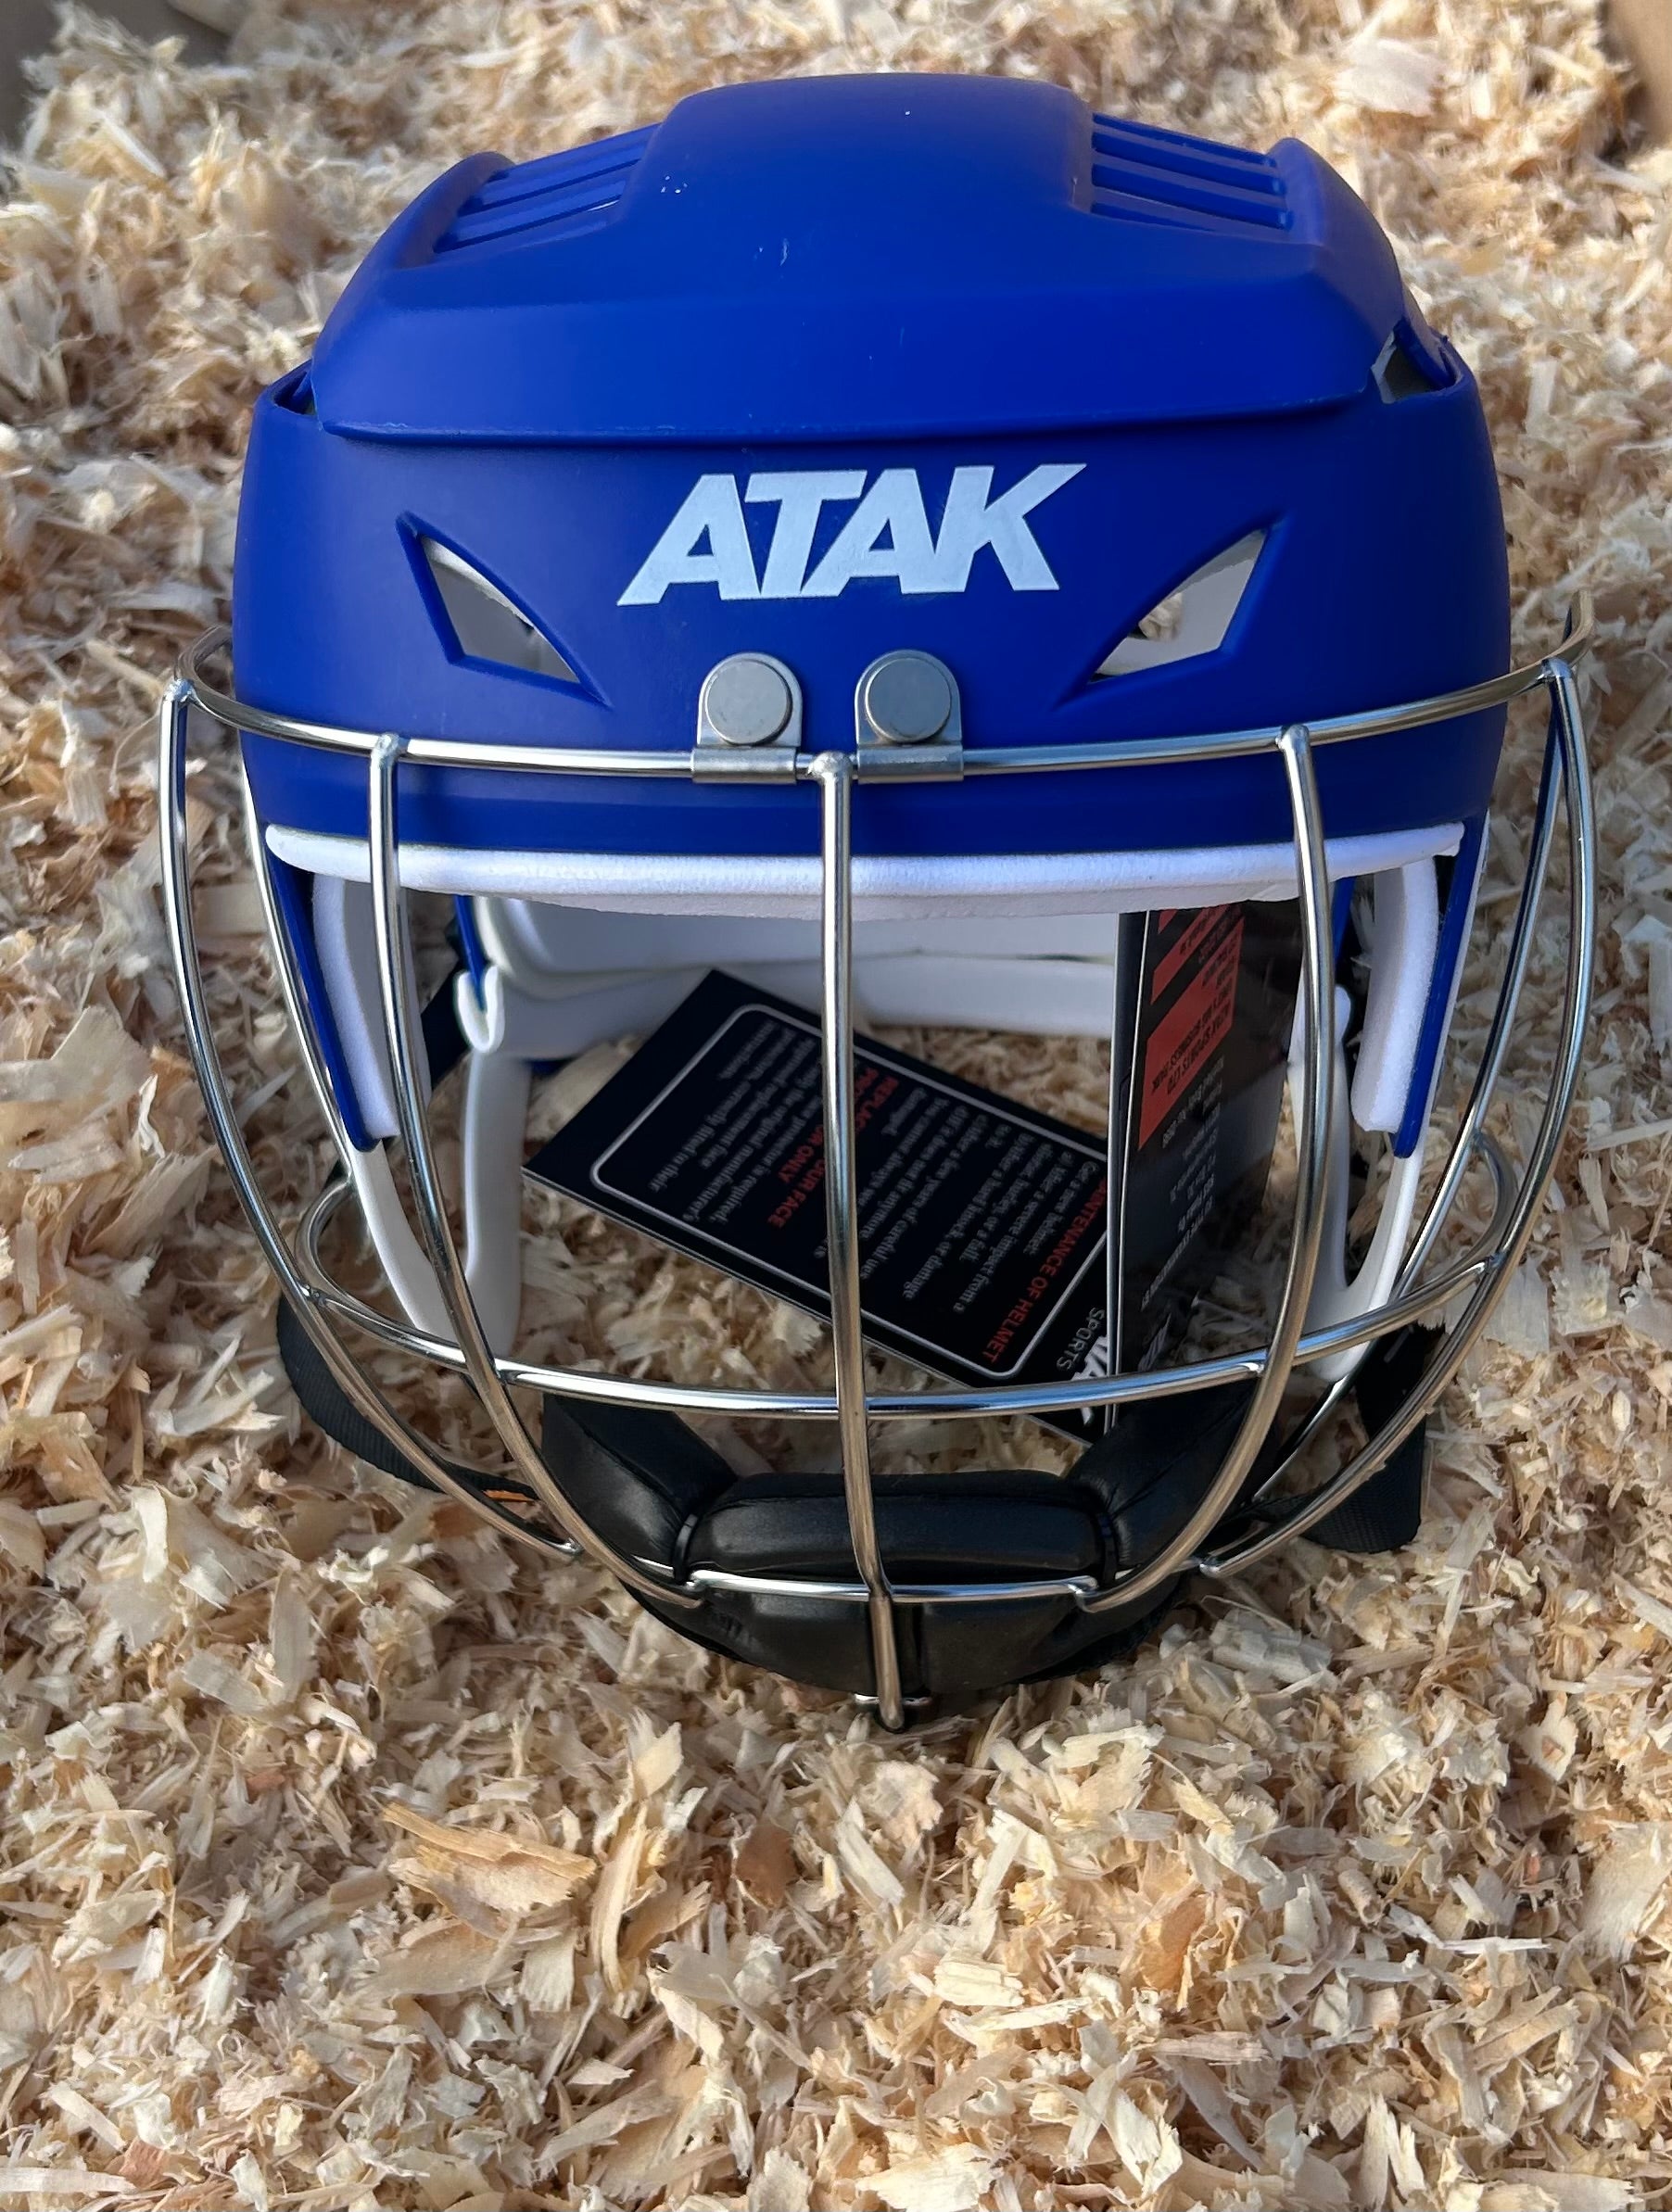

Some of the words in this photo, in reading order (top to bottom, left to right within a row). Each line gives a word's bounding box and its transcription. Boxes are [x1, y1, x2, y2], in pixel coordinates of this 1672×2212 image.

[617, 463, 1086, 606] ATAK
[744, 1103, 791, 1148] original
[695, 1143, 728, 1171] face
[918, 1133, 949, 1163] does
[948, 1148, 963, 1160] a
[644, 1162, 681, 1194] their
[748, 1163, 770, 1179] is
[773, 1142, 817, 1185] ONLY
[796, 1157, 834, 1193] OUR
[864, 1148, 907, 1191] always
[904, 1158, 928, 1181] not
[932, 1157, 961, 1182] few
[989, 1169, 1004, 1180] a
[907, 1175, 943, 1209] years
[970, 1177, 1002, 1207] hard
[1032, 1190, 1046, 1201] a
[1068, 1178, 1083, 1191] a
[766, 1189, 808, 1230] FACE
[900, 1206, 924, 1225] of
[1052, 1187, 1077, 1214] new
[981, 1214, 1000, 1232] or
[1007, 1199, 1040, 1236] severe
[1038, 1175, 1109, 1276] AINTENANCE
[872, 1219, 914, 1262] careful
[932, 1239, 952, 1257] or
[975, 1228, 990, 1240] a
[974, 1232, 1018, 1277] impact
[896, 1252, 945, 1302] damage
[959, 1272, 991, 1305] from
[1022, 1274, 1049, 1299] OF
[951, 1301, 967, 1314] a
[979, 1296, 1033, 1363] HELMET
[1053, 1306, 1106, 1371] SPORTS
